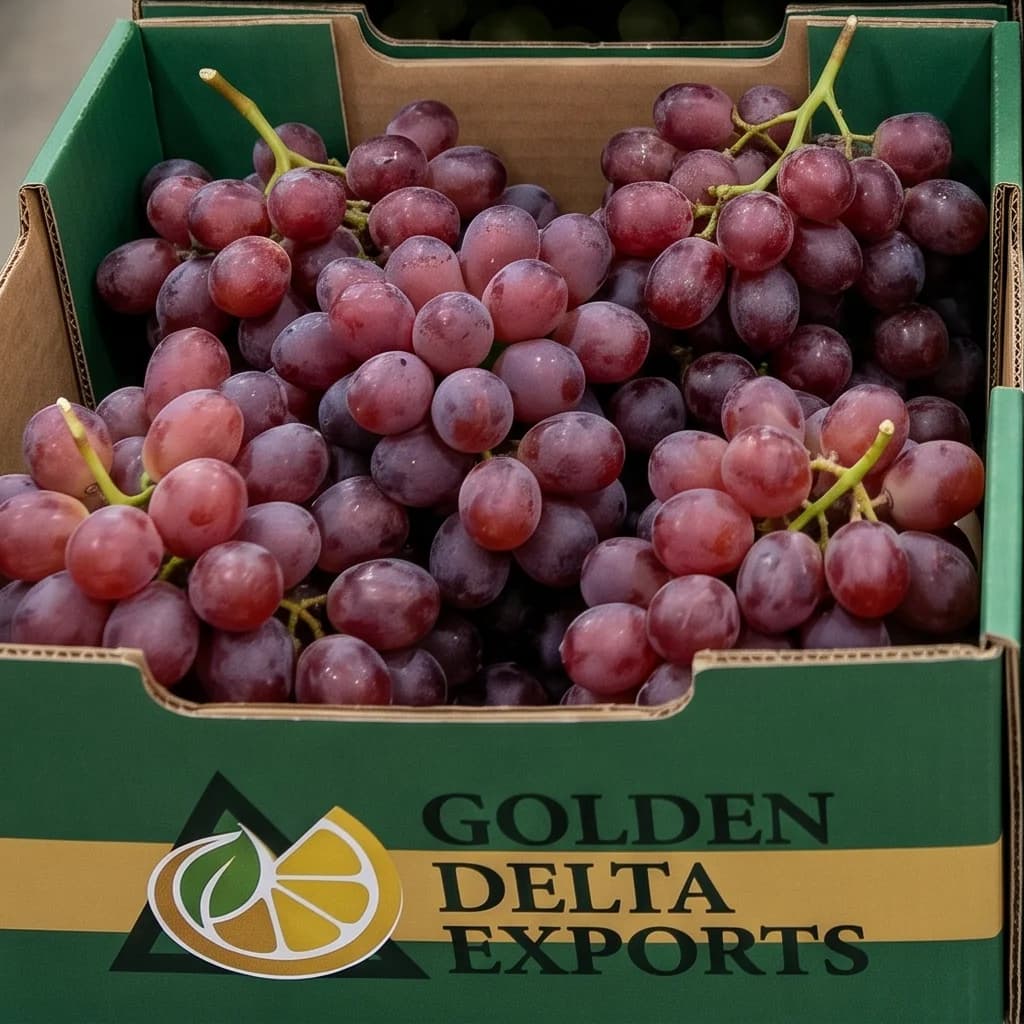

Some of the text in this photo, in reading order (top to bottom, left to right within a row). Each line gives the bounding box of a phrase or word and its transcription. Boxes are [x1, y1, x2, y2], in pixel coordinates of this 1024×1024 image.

[421, 791, 836, 848] GOLDEN
[432, 861, 736, 914] DELTA
[442, 925, 870, 977] EXPORTS
